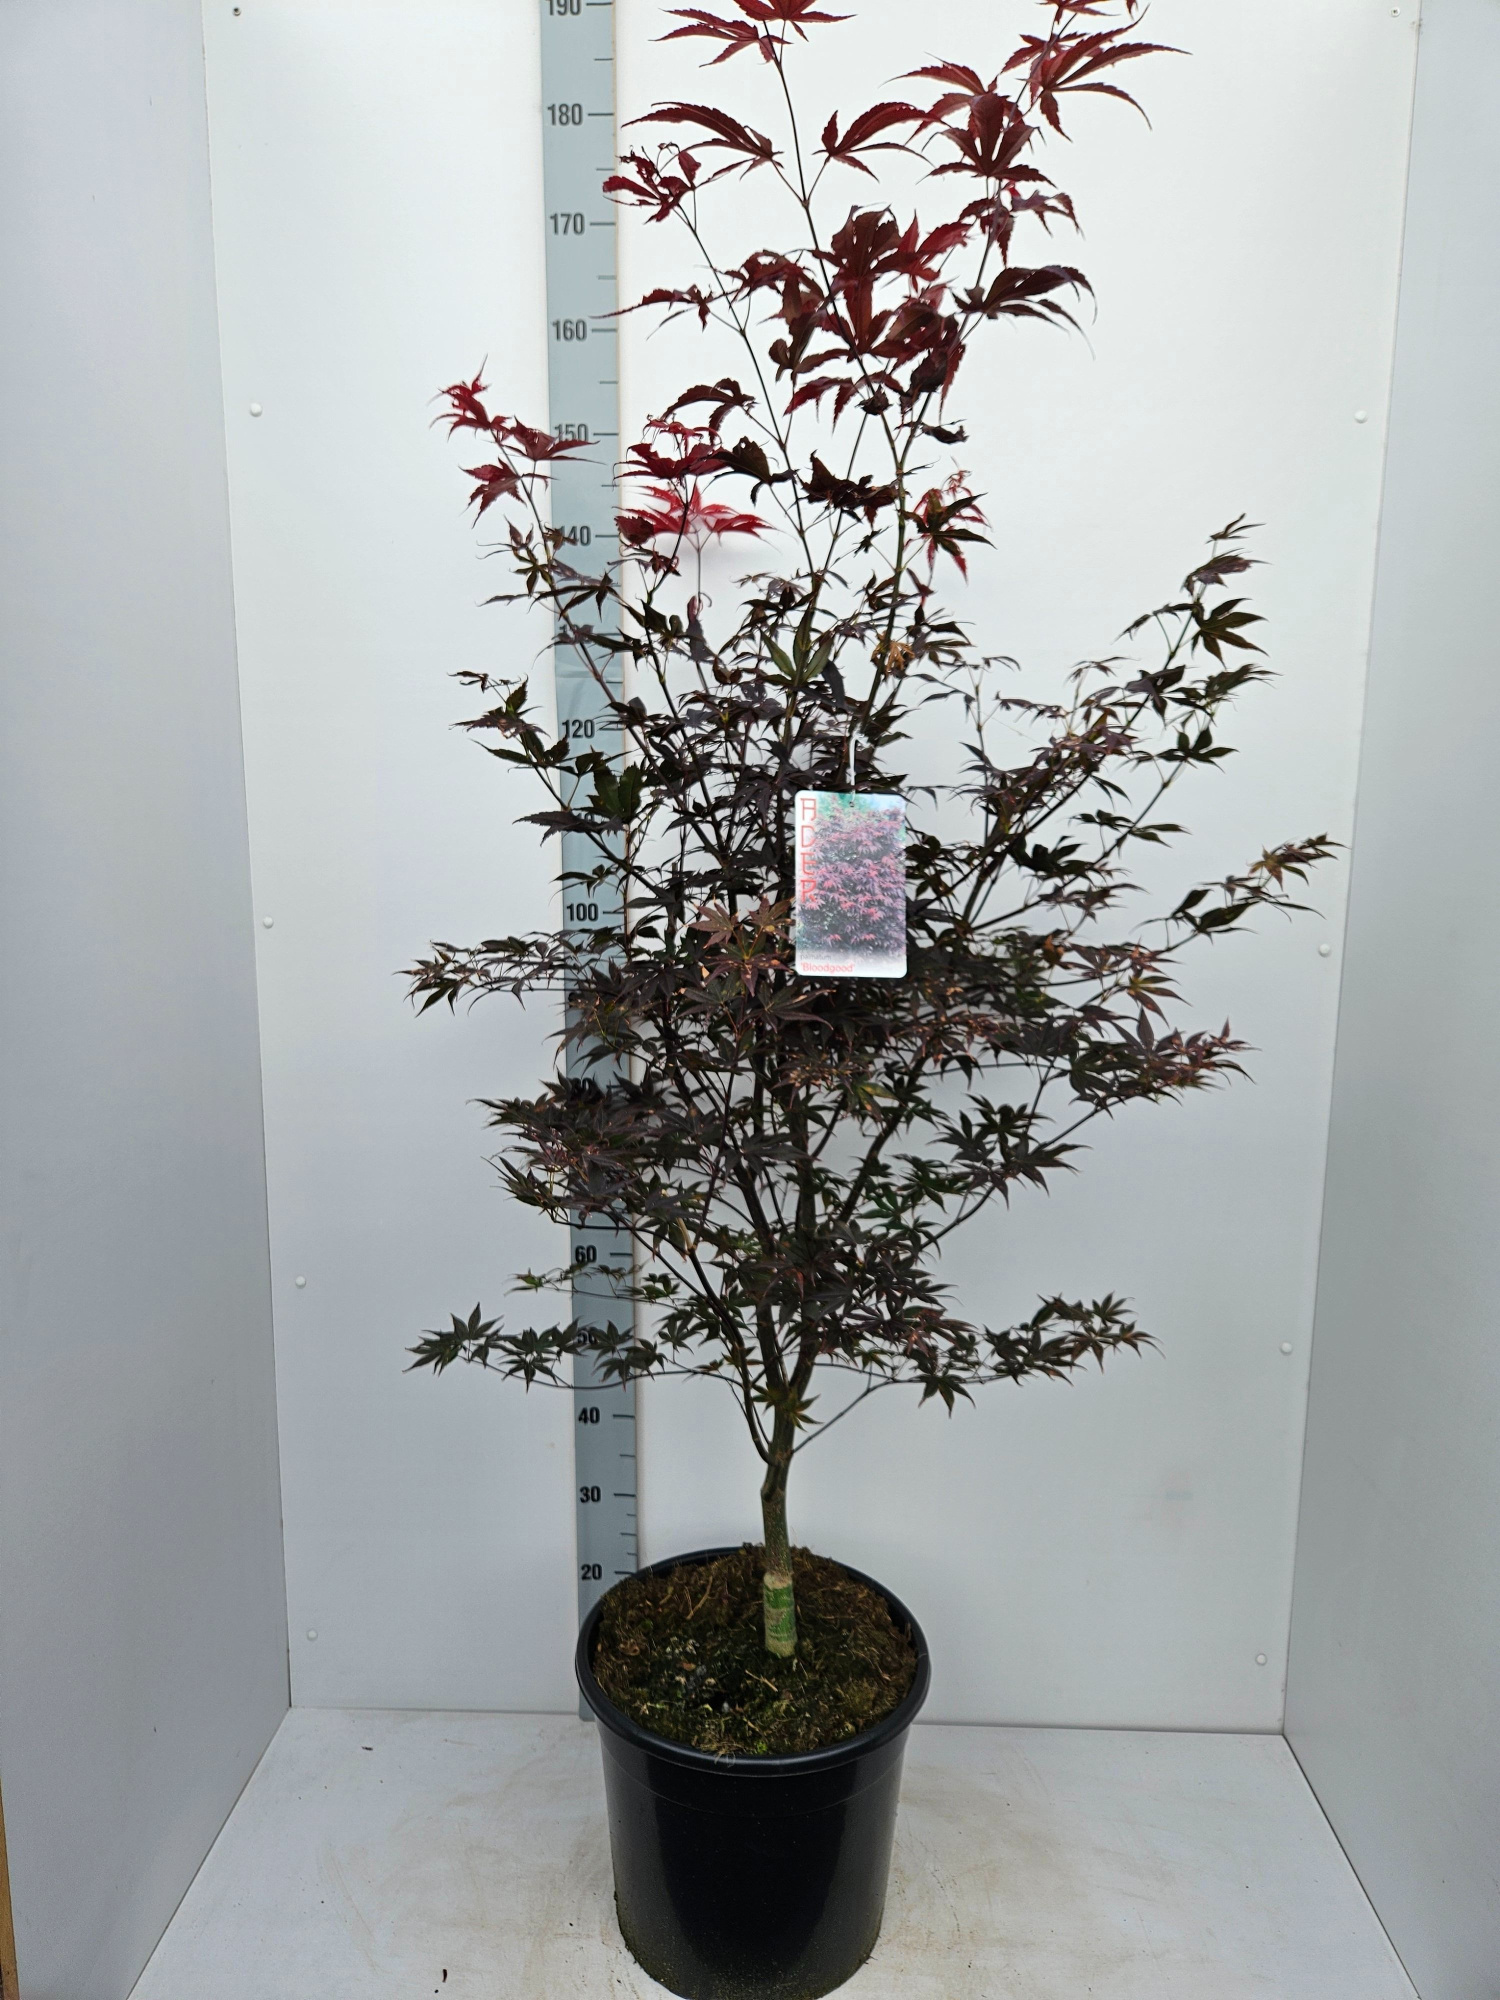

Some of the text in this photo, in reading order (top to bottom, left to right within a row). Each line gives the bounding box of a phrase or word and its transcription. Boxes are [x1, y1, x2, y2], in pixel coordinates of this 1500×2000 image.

[547, 0, 582, 16] 190
[547, 103, 583, 126] 180
[549, 212, 585, 235] 170
[552, 319, 587, 341] 160
[554, 424, 588, 442] 150
[561, 719, 595, 739] 120
[566, 903, 599, 921] 100
[575, 1245, 597, 1263] 60
[578, 1406, 600, 1424] 40
[580, 1486, 601, 1503] 30
[581, 1564, 602, 1580] 20
